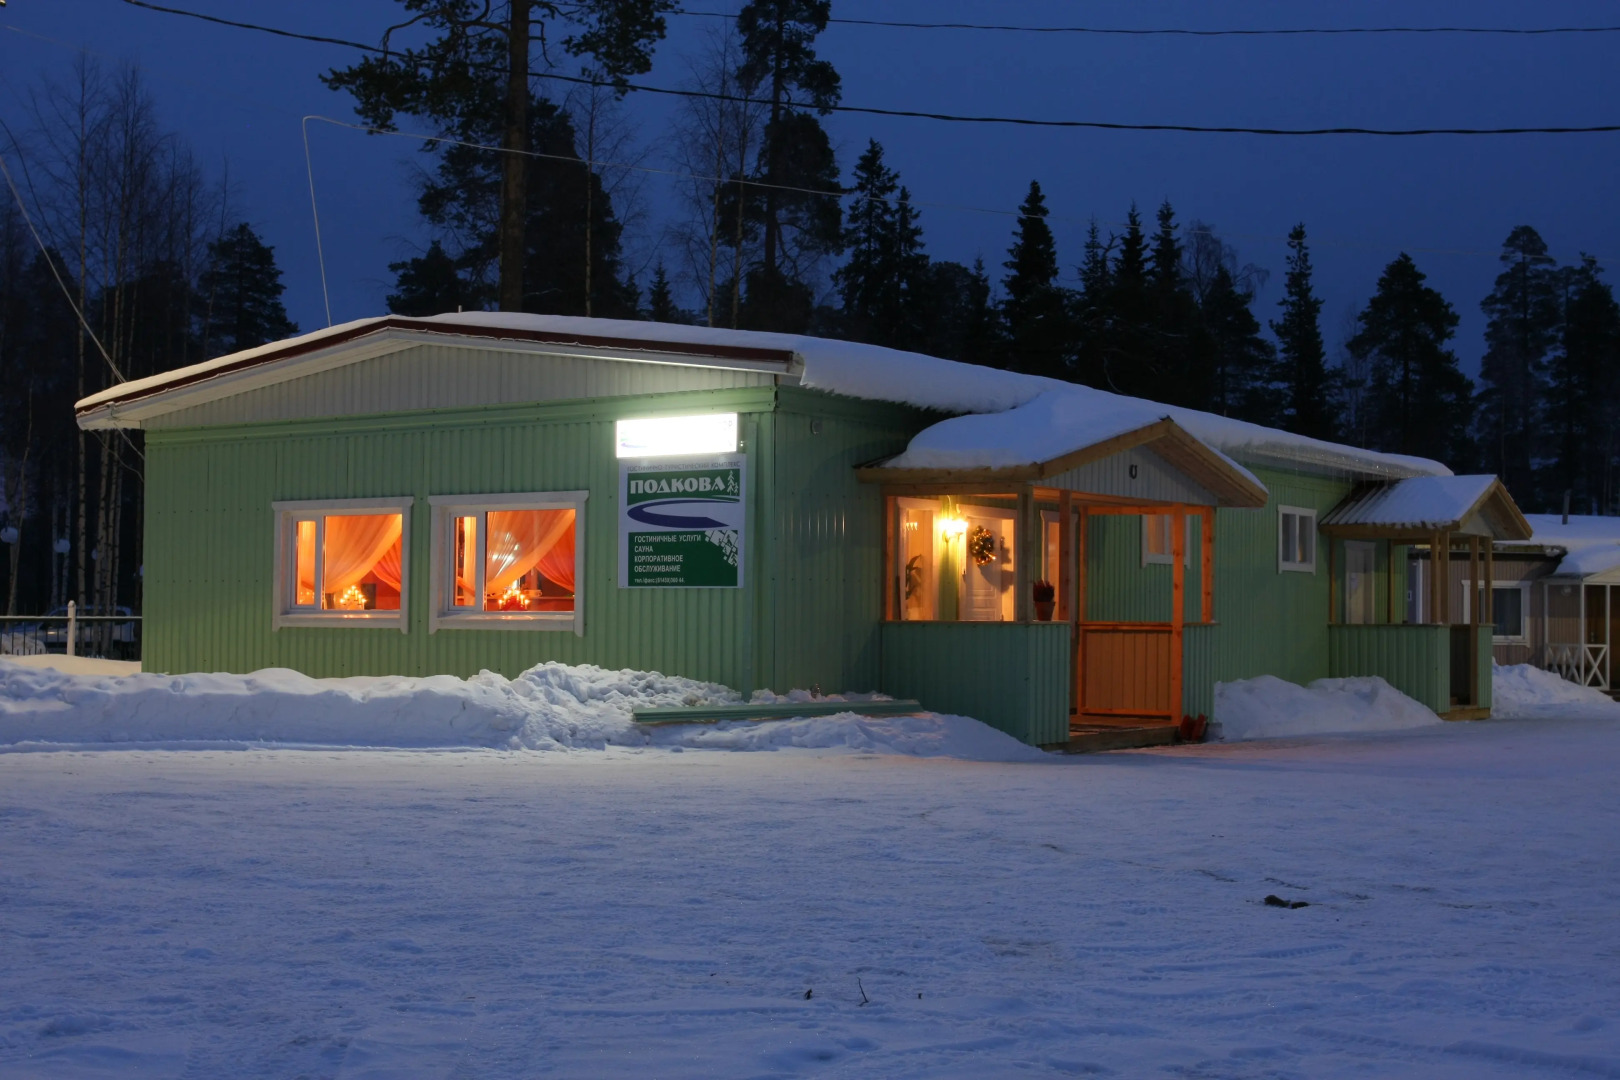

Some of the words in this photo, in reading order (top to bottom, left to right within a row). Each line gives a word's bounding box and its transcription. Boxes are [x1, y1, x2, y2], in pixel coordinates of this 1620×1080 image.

[630, 475, 725, 494] ПОДКОВА
[634, 535, 677, 543] ГОСТИНИЧНЫЕ
[679, 534, 701, 542] УСЛУГИ
[634, 545, 653, 553] САУНА
[634, 555, 683, 563] КОРПОРАТИВНОЕ
[634, 565, 681, 573] ОБСЛУЖИВАНИЕ
